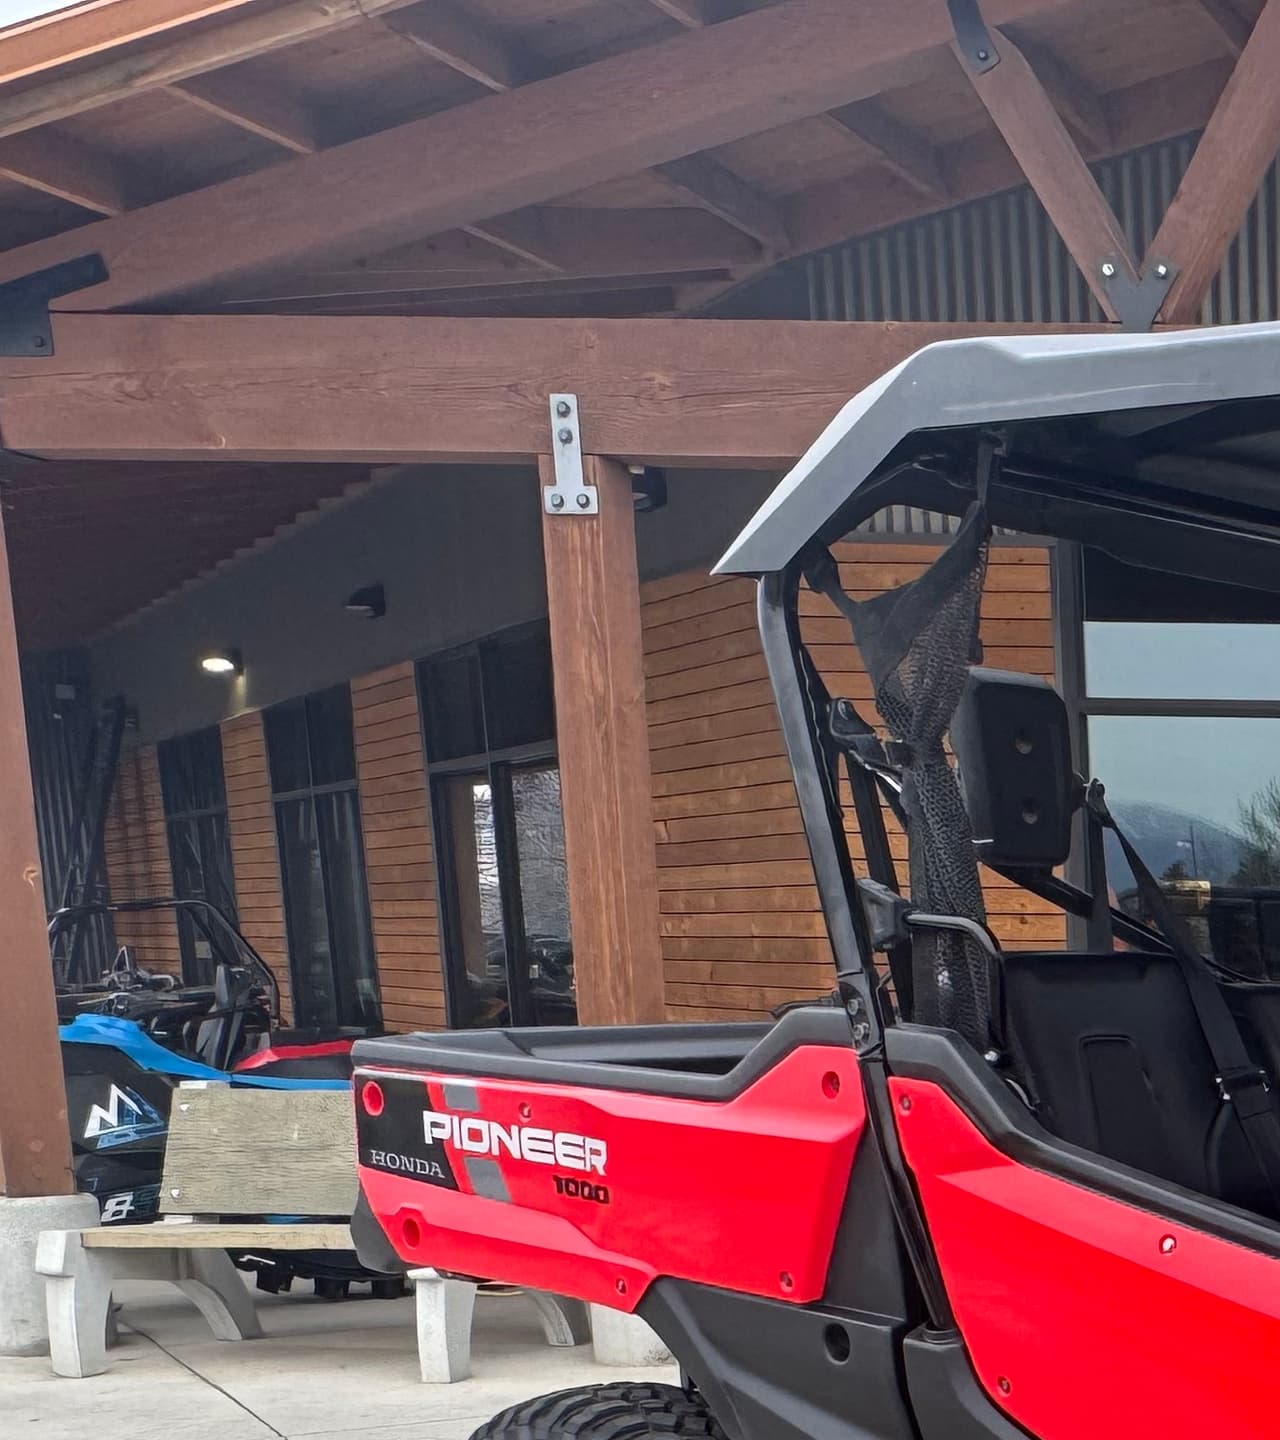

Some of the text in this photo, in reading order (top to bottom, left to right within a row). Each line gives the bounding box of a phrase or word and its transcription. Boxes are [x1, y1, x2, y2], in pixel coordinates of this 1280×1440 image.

[422, 1110, 608, 1175] PIONEER
[370, 1149, 445, 1179] HONDA
[552, 1175, 610, 1204] 1000
